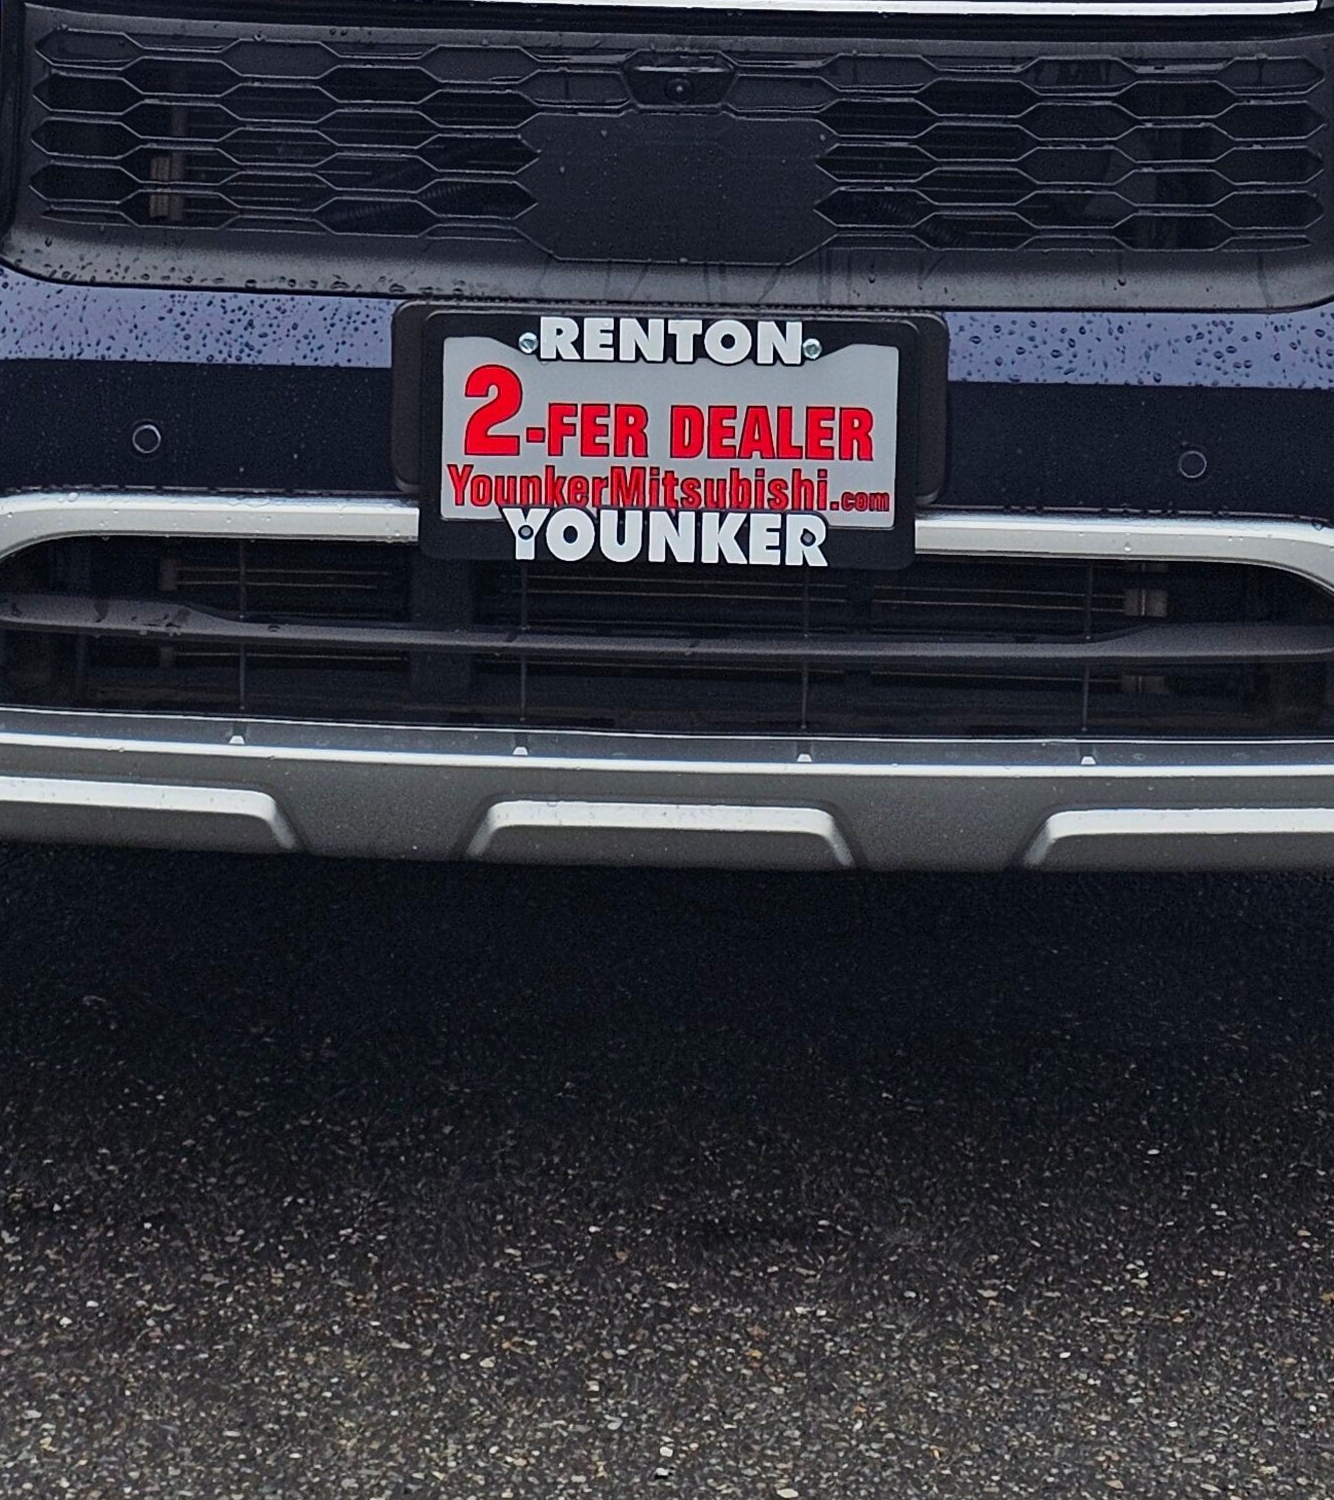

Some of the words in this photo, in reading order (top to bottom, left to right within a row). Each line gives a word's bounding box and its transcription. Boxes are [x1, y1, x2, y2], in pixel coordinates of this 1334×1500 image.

[539, 316, 803, 365] RENTON
[464, 364, 648, 458] 2-FER
[669, 403, 874, 462] DEALER
[447, 463, 890, 513] YounkerMitsubishi.com
[507, 507, 829, 568] YOUNKER
